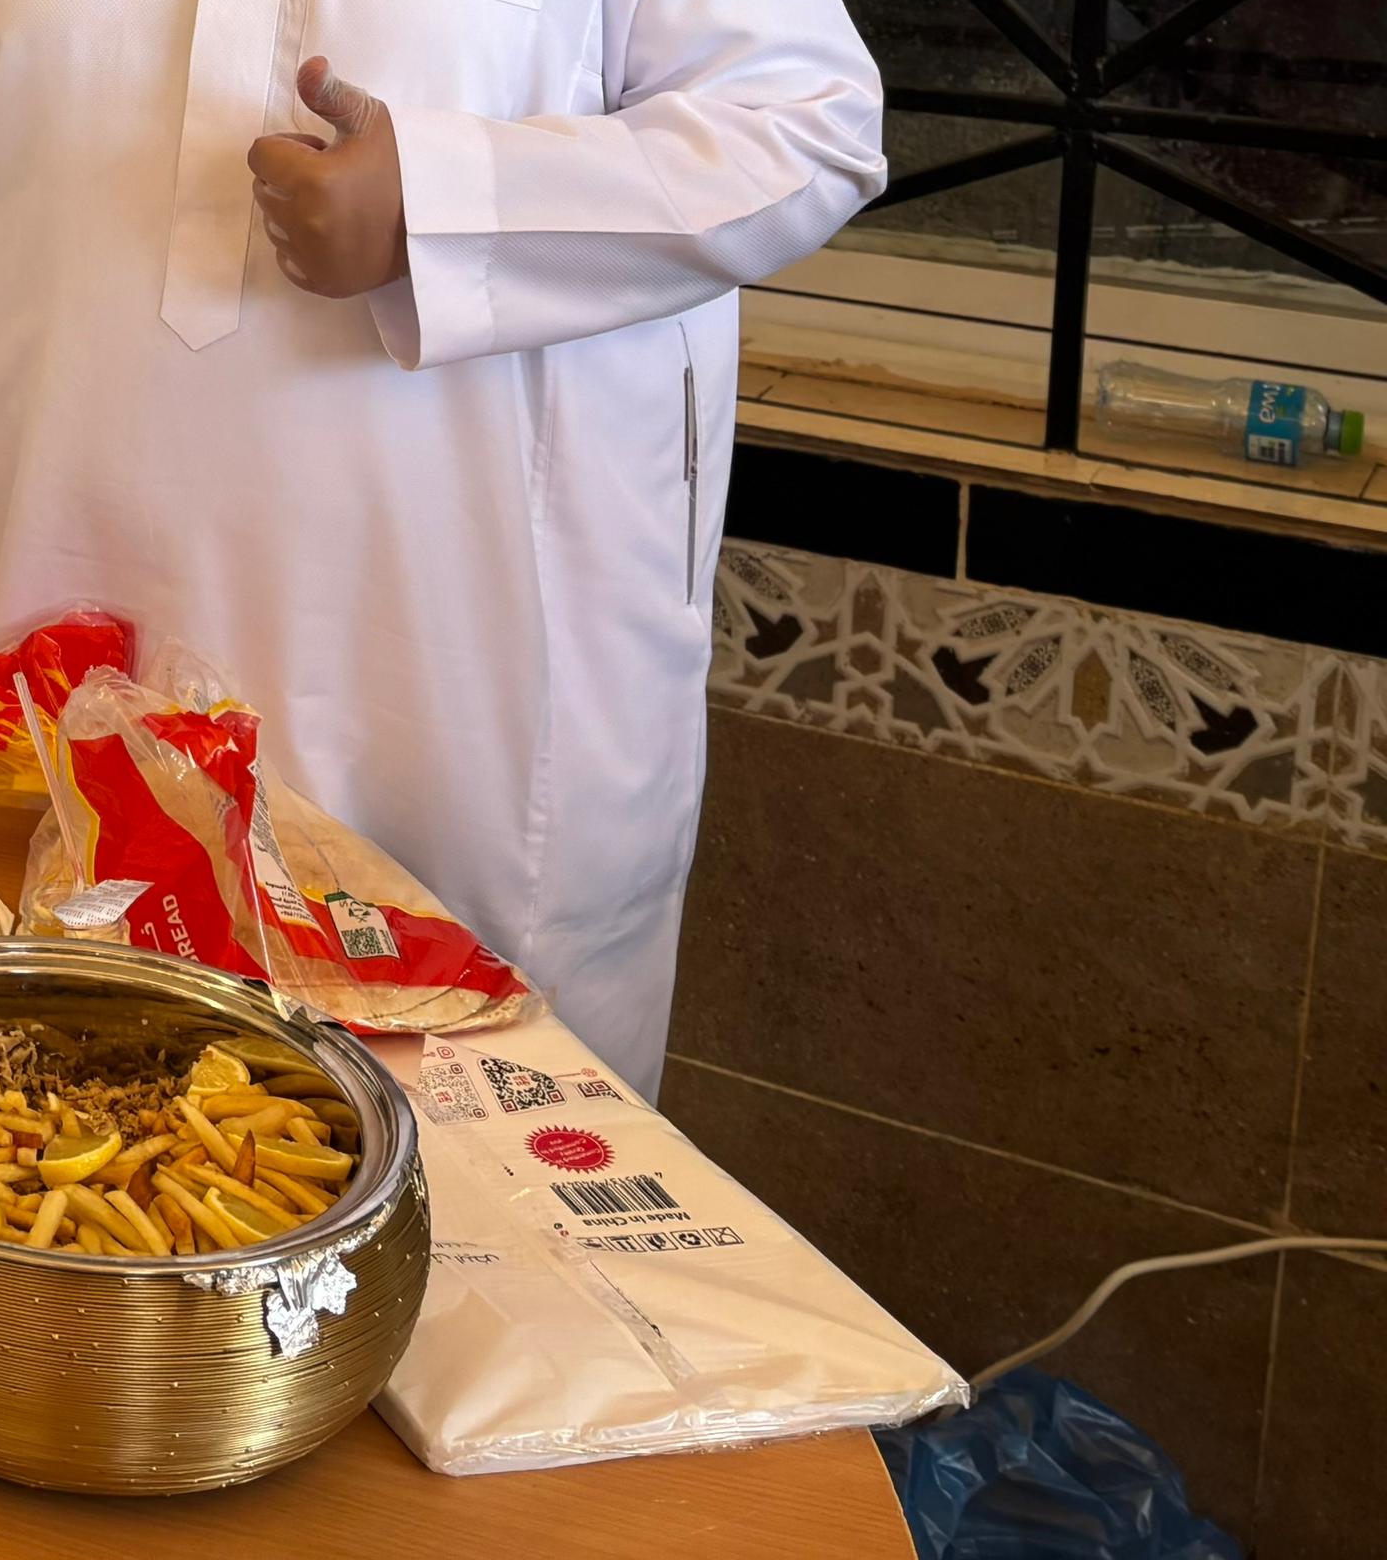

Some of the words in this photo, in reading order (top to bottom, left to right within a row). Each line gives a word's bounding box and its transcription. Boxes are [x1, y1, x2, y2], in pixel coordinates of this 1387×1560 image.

[162, 893, 200, 962] READ
[582, 1217, 628, 1227] China
[648, 1210, 692, 1223] Made
